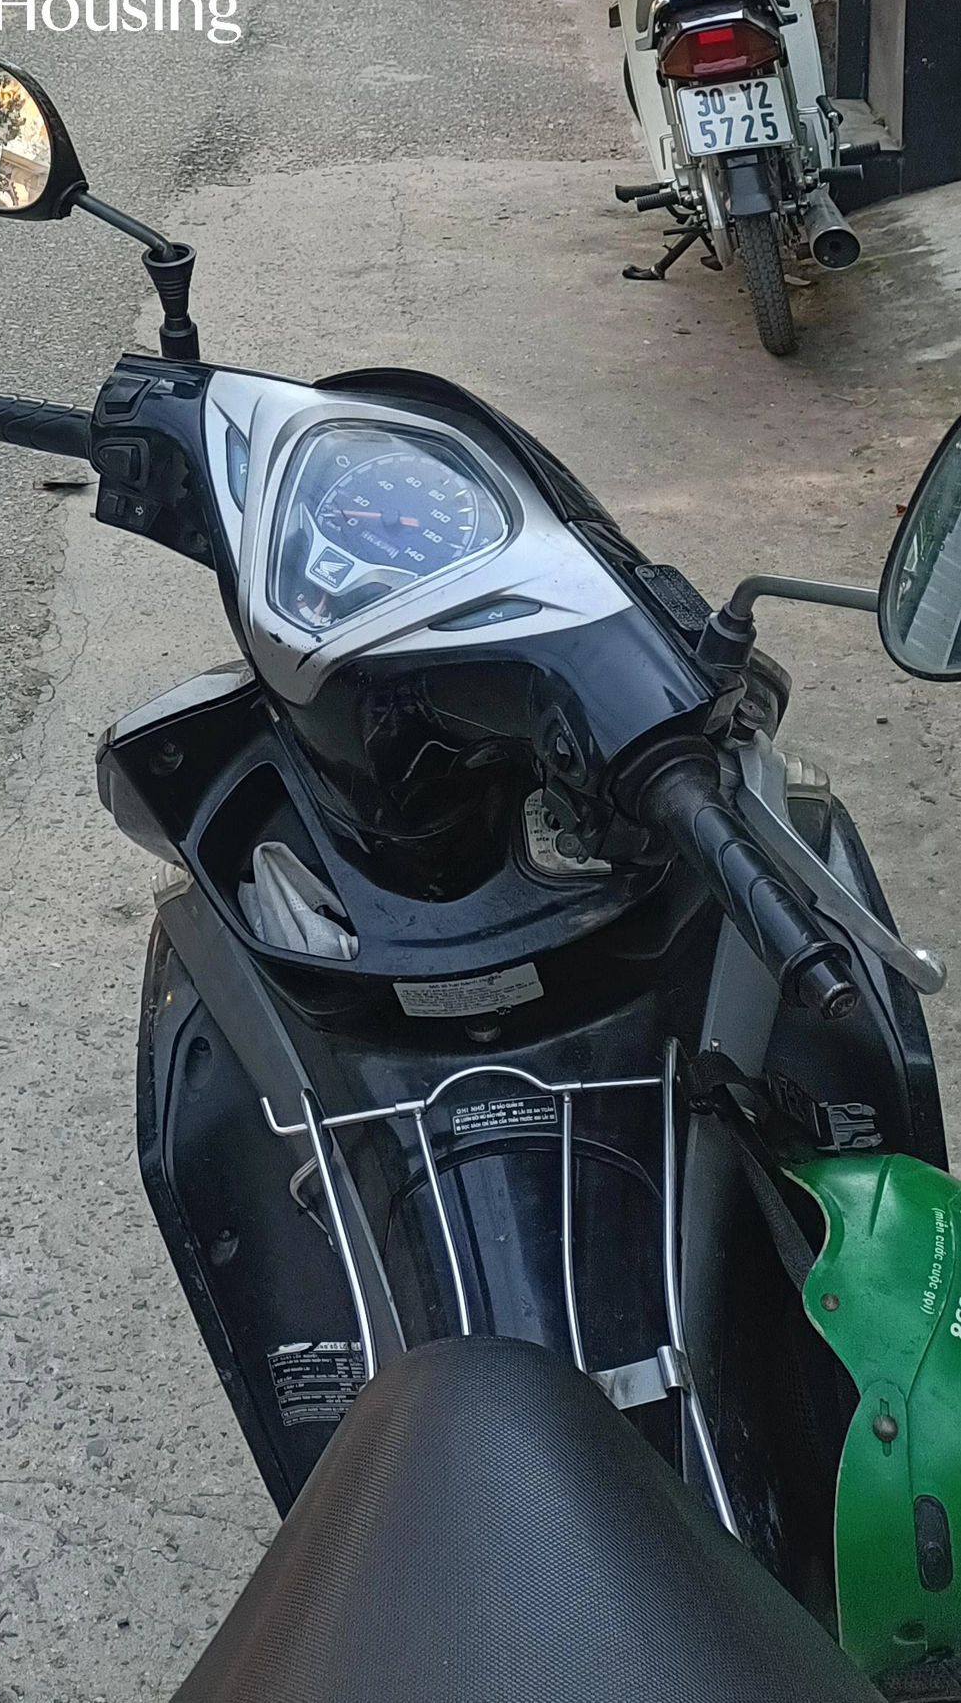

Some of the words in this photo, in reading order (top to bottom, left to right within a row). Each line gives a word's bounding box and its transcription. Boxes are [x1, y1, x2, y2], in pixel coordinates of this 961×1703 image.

[694, 81, 773, 118] 30-Y2
[699, 112, 779, 148] 5725
[377, 480, 394, 491] 40
[405, 476, 422, 488] 60
[352, 494, 370, 507] 20
[346, 517, 359, 527] 0
[430, 509, 451, 524] 100
[422, 528, 443, 544] 120
[403, 547, 426, 562] 140
[314, 566, 338, 584] HONDA
[456, 1107, 470, 1115] GHI
[470, 1102, 486, 1113] NHỚ
[931, 1207, 949, 1233] (miễn
[934, 1234, 947, 1261] cước
[927, 1262, 943, 1290] cuộc
[920, 1290, 936, 1315] gọi)
